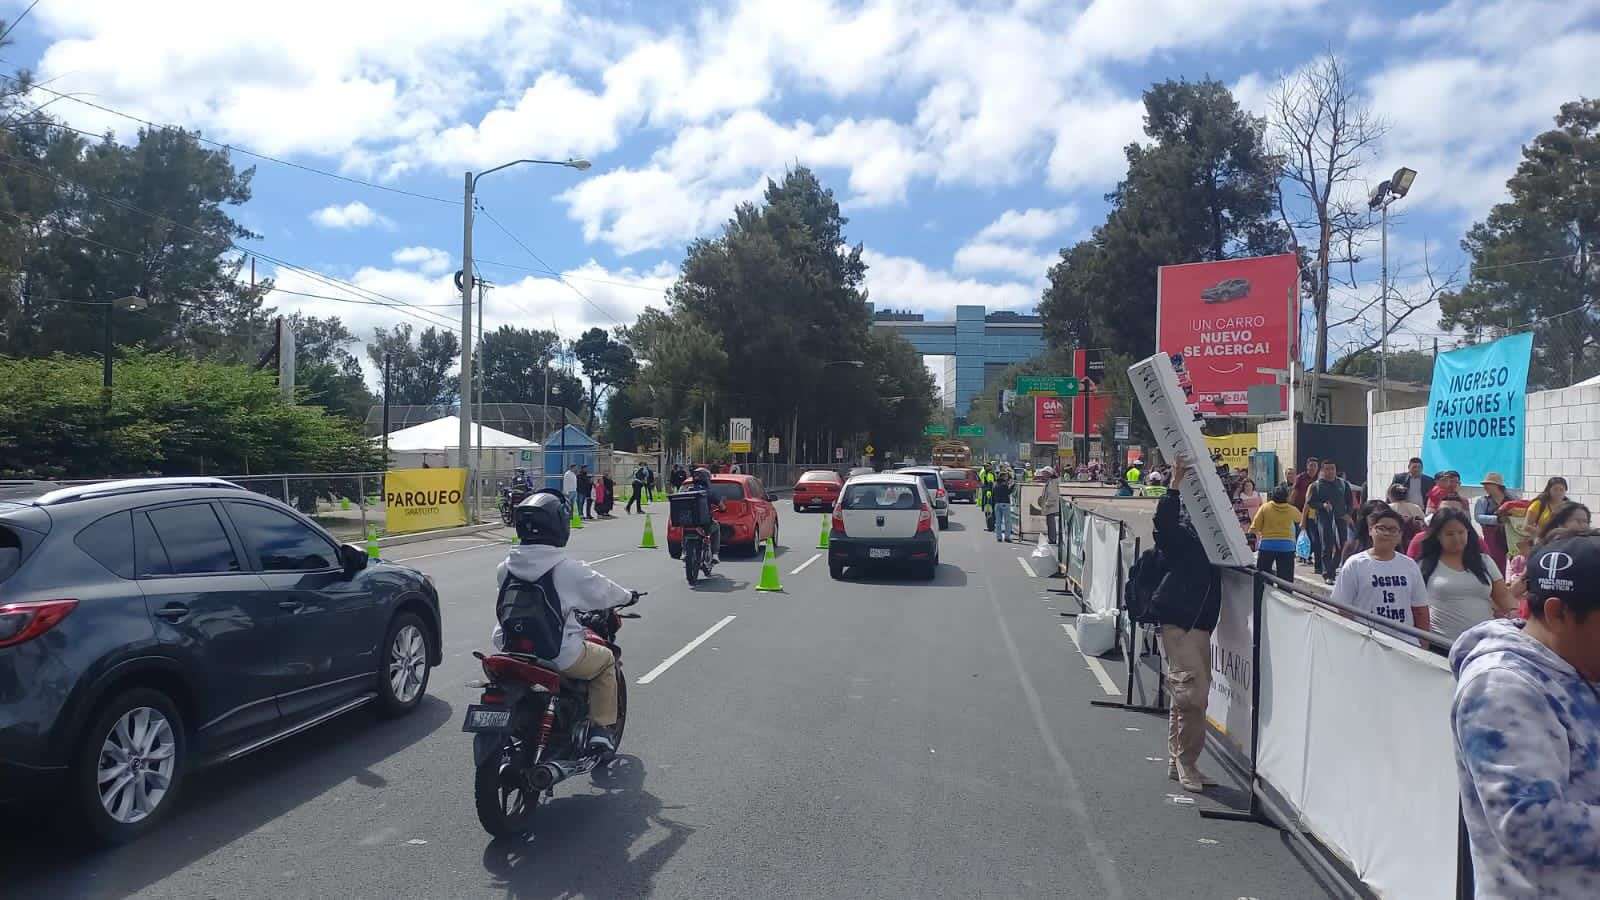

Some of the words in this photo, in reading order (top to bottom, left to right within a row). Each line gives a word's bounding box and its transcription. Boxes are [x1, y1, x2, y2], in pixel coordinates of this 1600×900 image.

[1216, 315, 1265, 330] CARRO
[1200, 330, 1252, 343] NUEVO
[1183, 345, 1201, 357] SE
[1204, 341, 1270, 356] ACERCA!
[1449, 366, 1509, 394] INGRESO
[1435, 392, 1502, 418] PASTORES
[1507, 390, 1516, 411] Y
[1431, 415, 1516, 440] SERVIDORES
[1208, 447, 1258, 457] RQUE
[387, 489, 461, 508] PARQUEO
[1371, 574, 1408, 588] Jesus
[1376, 605, 1406, 623] King
[1211, 643, 1251, 691] ILIARIO
